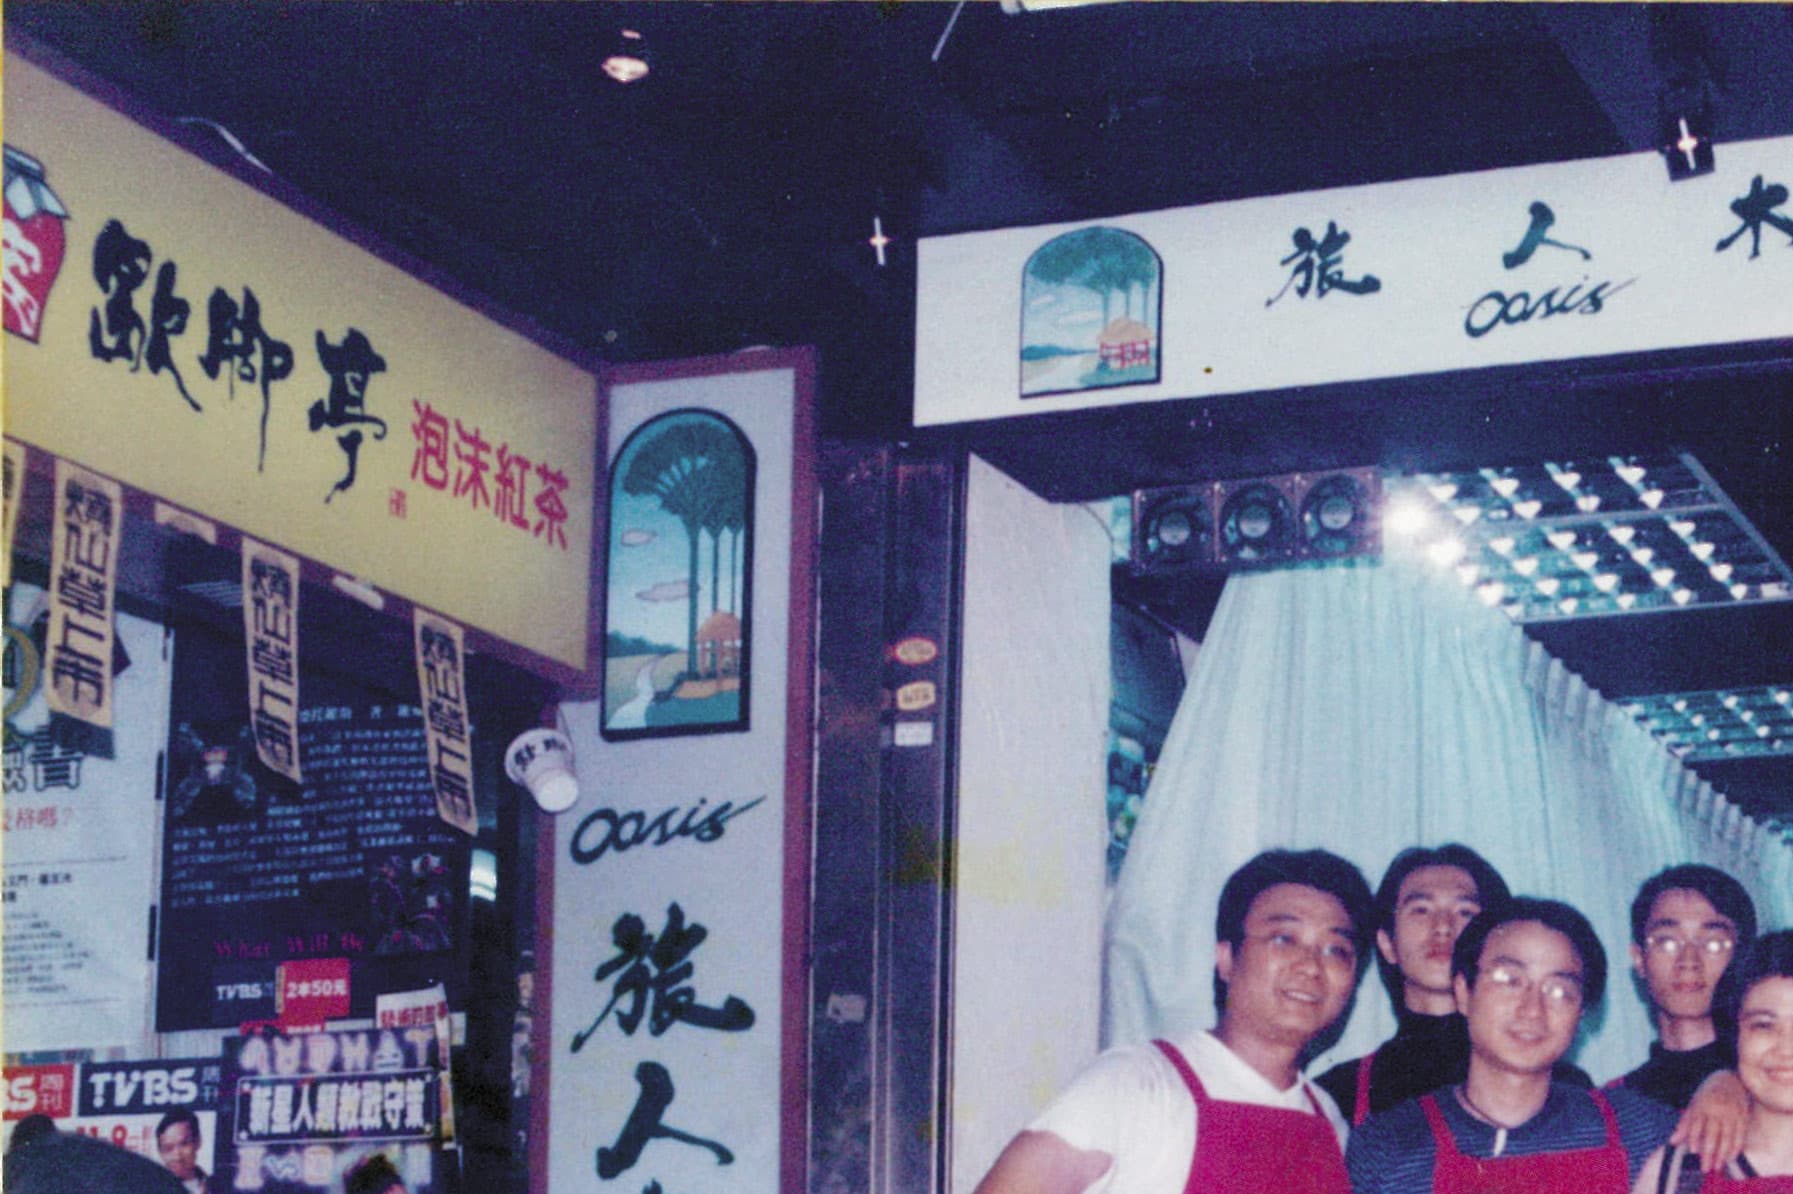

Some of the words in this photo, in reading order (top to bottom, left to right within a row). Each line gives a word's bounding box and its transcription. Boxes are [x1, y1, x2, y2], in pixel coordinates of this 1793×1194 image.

[1465, 275, 1635, 339] Oasis
[410, 401, 571, 551] 泡沫紅茶
[569, 795, 767, 866] Oasis
[89, 1066, 198, 1108] TVBS
